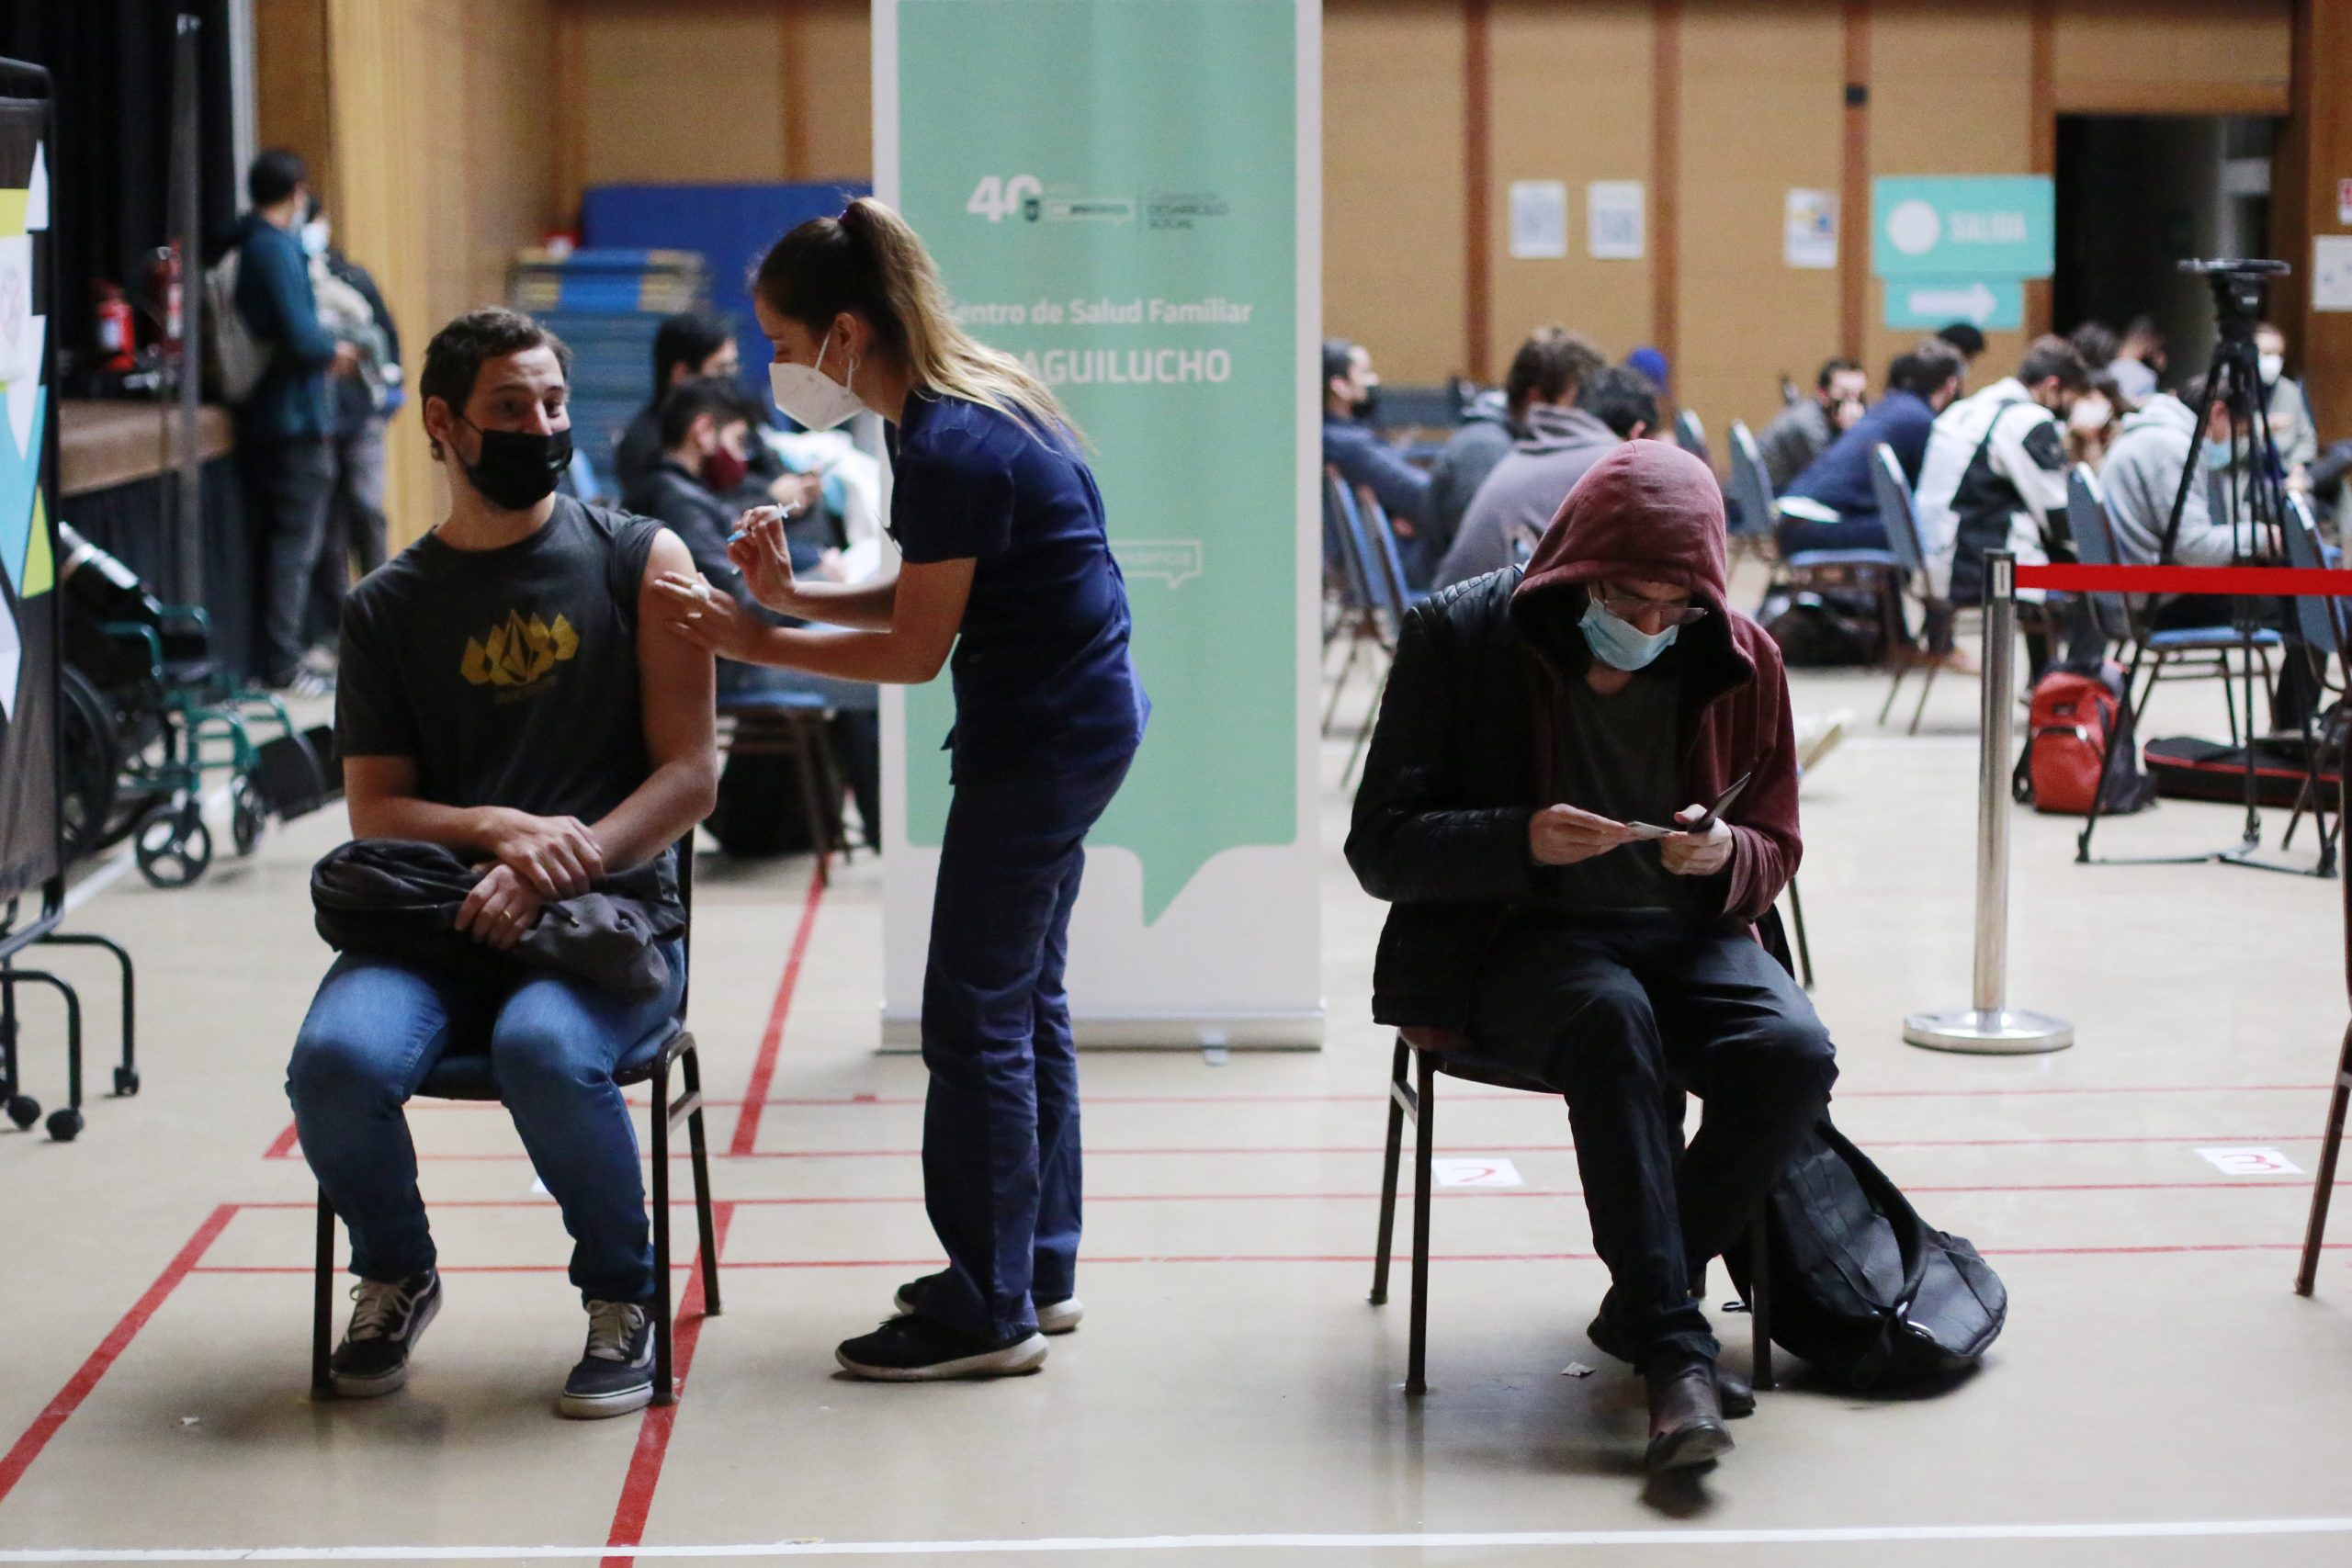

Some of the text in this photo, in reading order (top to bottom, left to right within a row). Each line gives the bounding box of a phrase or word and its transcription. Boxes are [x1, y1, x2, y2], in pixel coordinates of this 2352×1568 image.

[1031, 299, 1064, 323] de
[1069, 299, 1143, 323] Salud
[1149, 299, 1251, 323] Familiar
[1020, 348, 1232, 384] AGUILUCHO
